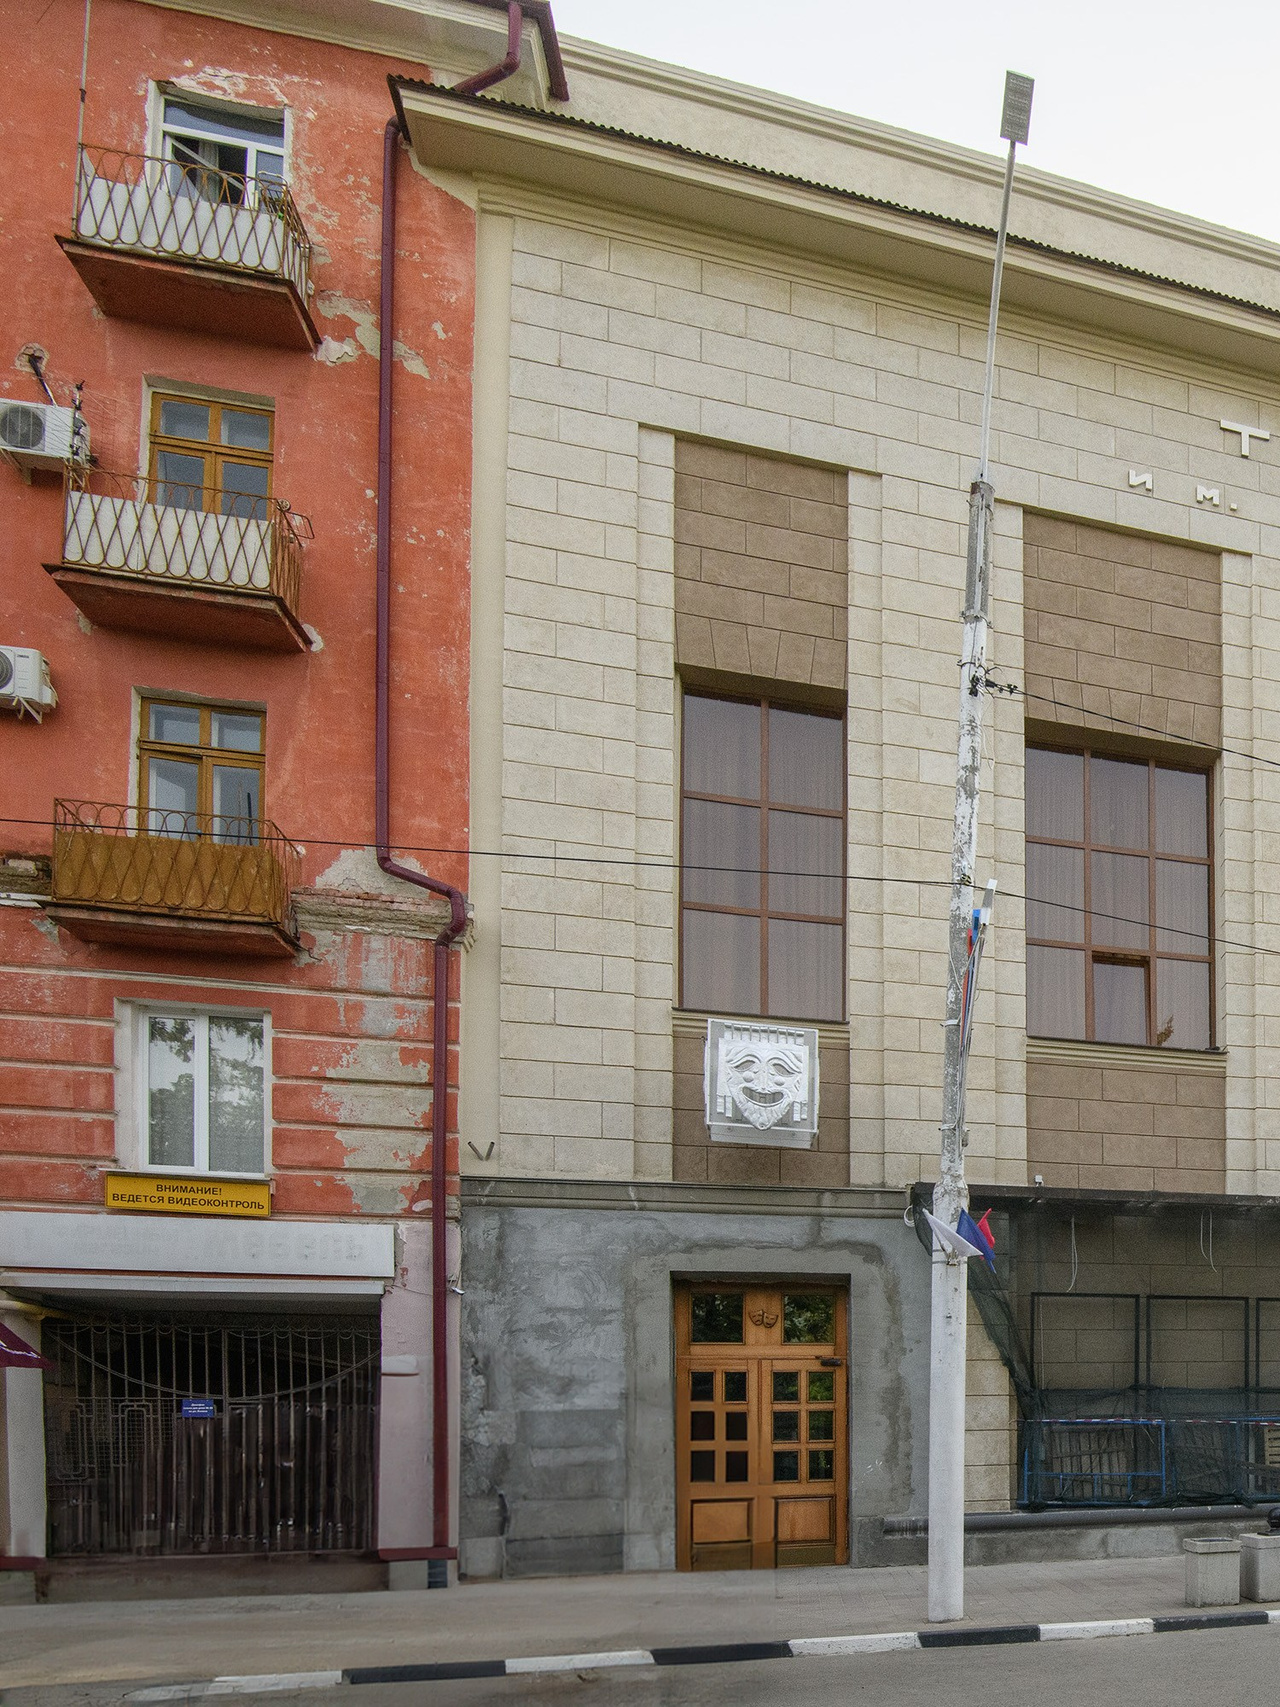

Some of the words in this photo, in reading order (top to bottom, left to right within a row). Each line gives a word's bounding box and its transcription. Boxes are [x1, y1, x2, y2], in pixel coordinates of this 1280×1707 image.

[156, 1184, 222, 1195] ВНИМАНИЕ!
[112, 1193, 165, 1204] ВЕДЕТСЯ
[168, 1196, 265, 1210] ВИДЕОКОНТРОЛЬ
